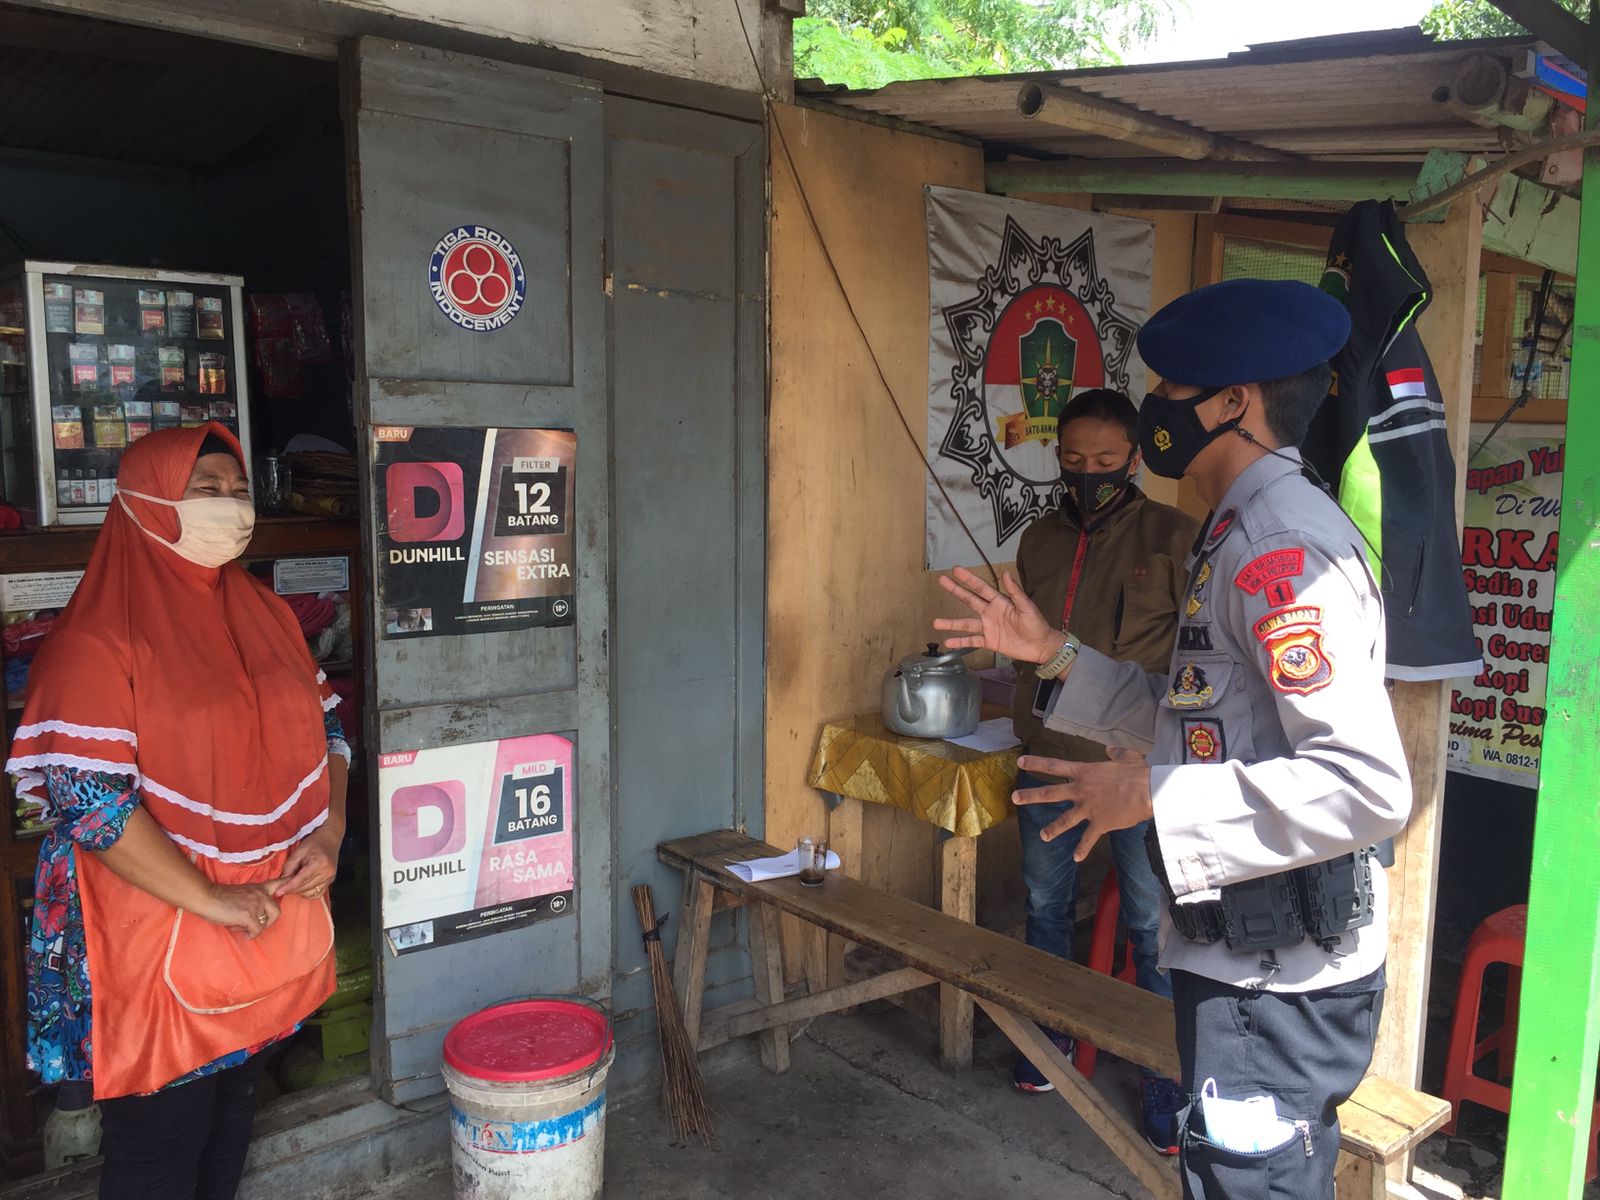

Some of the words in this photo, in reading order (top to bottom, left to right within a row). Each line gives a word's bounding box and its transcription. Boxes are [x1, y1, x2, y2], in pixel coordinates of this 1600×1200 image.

[434, 227, 470, 256] TIGA
[474, 226, 520, 267] RODA
[430, 281, 524, 331] INDOCEMENT
[378, 429, 408, 439] BARU
[520, 461, 551, 469] FILTER
[514, 482, 551, 514] 12
[1495, 494, 1526, 515] Di
[508, 515, 559, 527] BATANG
[389, 547, 465, 565] DUNHILL
[484, 548, 555, 566] SENSASI
[516, 563, 570, 581] EXTRA
[1275, 585, 1286, 602] 1
[1463, 569, 1523, 597] Sedia
[1259, 615, 1283, 635] JAWA
[1502, 603, 1553, 631] Udu
[1473, 664, 1529, 695] Kopi
[1501, 698, 1547, 726] Sus
[1501, 723, 1541, 747] Pes
[383, 754, 412, 766] BARU
[522, 763, 546, 775] MILD
[1506, 753, 1539, 769] 0812-1
[515, 784, 551, 819] 16
[508, 815, 557, 832] BATANG
[489, 850, 538, 872] RASA
[393, 859, 466, 885] DUNHILL
[513, 861, 566, 884] SAMA
